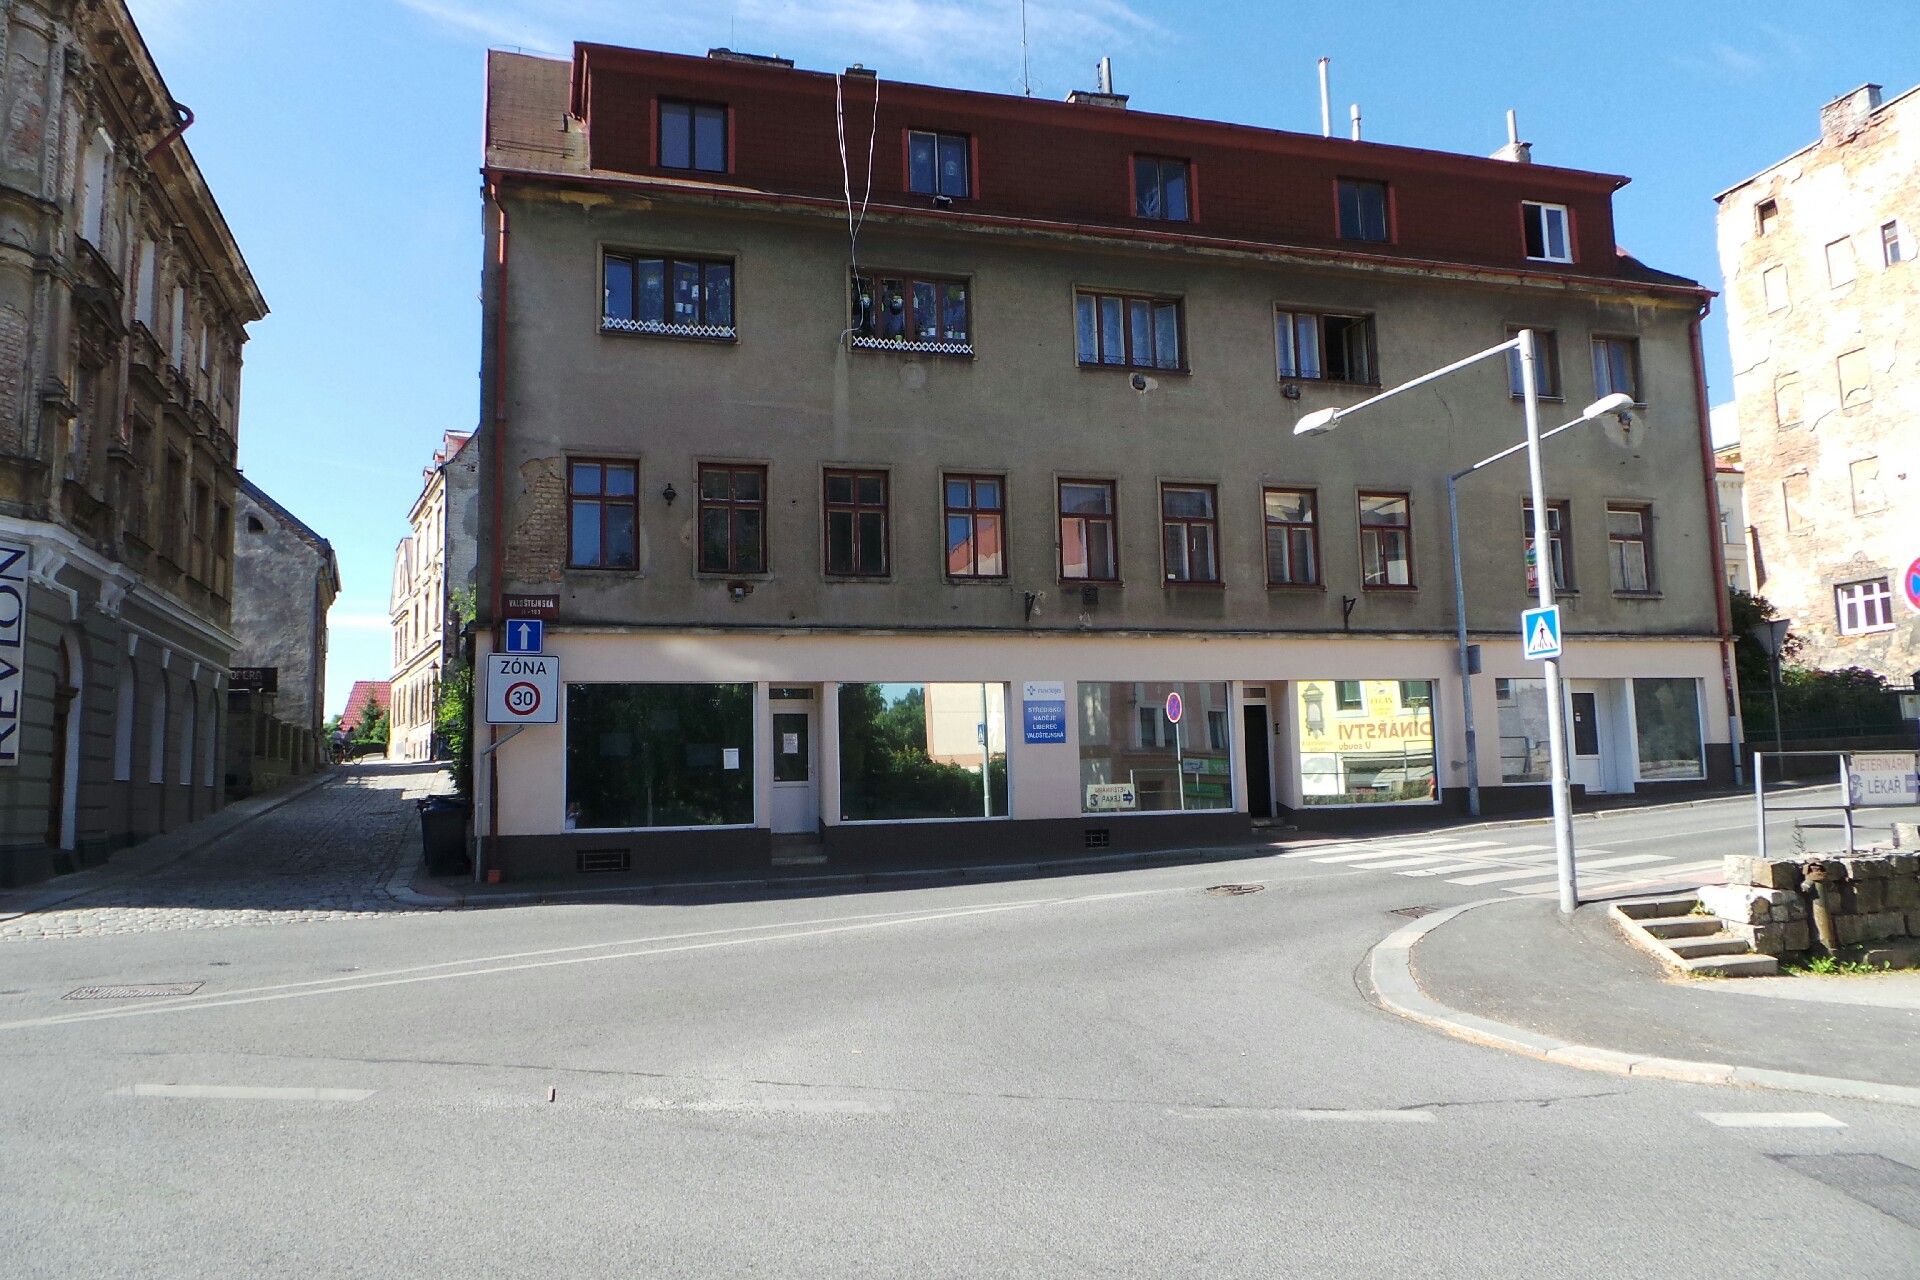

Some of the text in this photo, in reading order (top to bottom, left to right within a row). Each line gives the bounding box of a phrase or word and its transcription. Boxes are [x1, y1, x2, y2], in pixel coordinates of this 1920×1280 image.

[500, 658, 547, 675] ZÓNA
[512, 691, 533, 706] 30
[1867, 775, 1901, 794] LÉKAŘ
